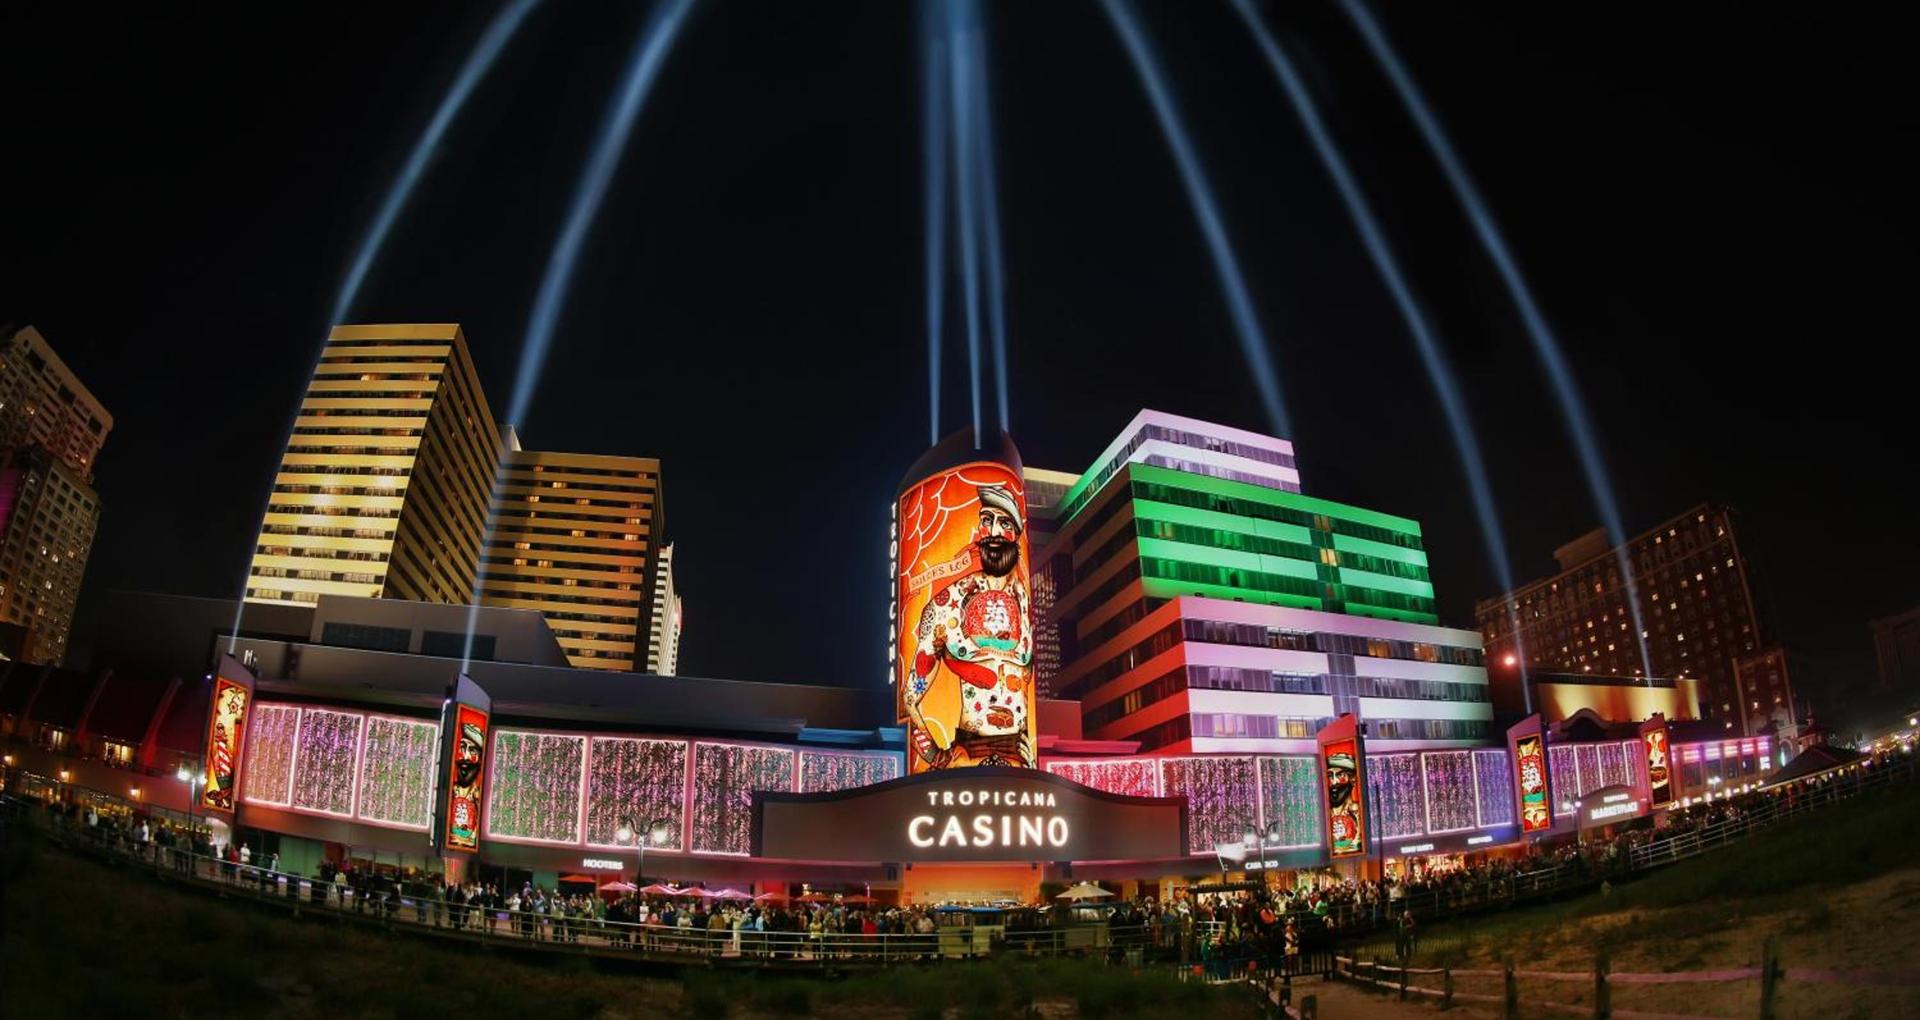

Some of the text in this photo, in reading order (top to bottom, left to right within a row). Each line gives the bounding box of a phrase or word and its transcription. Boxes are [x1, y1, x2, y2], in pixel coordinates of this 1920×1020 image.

[888, 502, 898, 685] TROPICANA
[928, 791, 1056, 807] TROPICANA
[908, 815, 1069, 847] CASINO
[583, 858, 624, 870] HOOTERS
